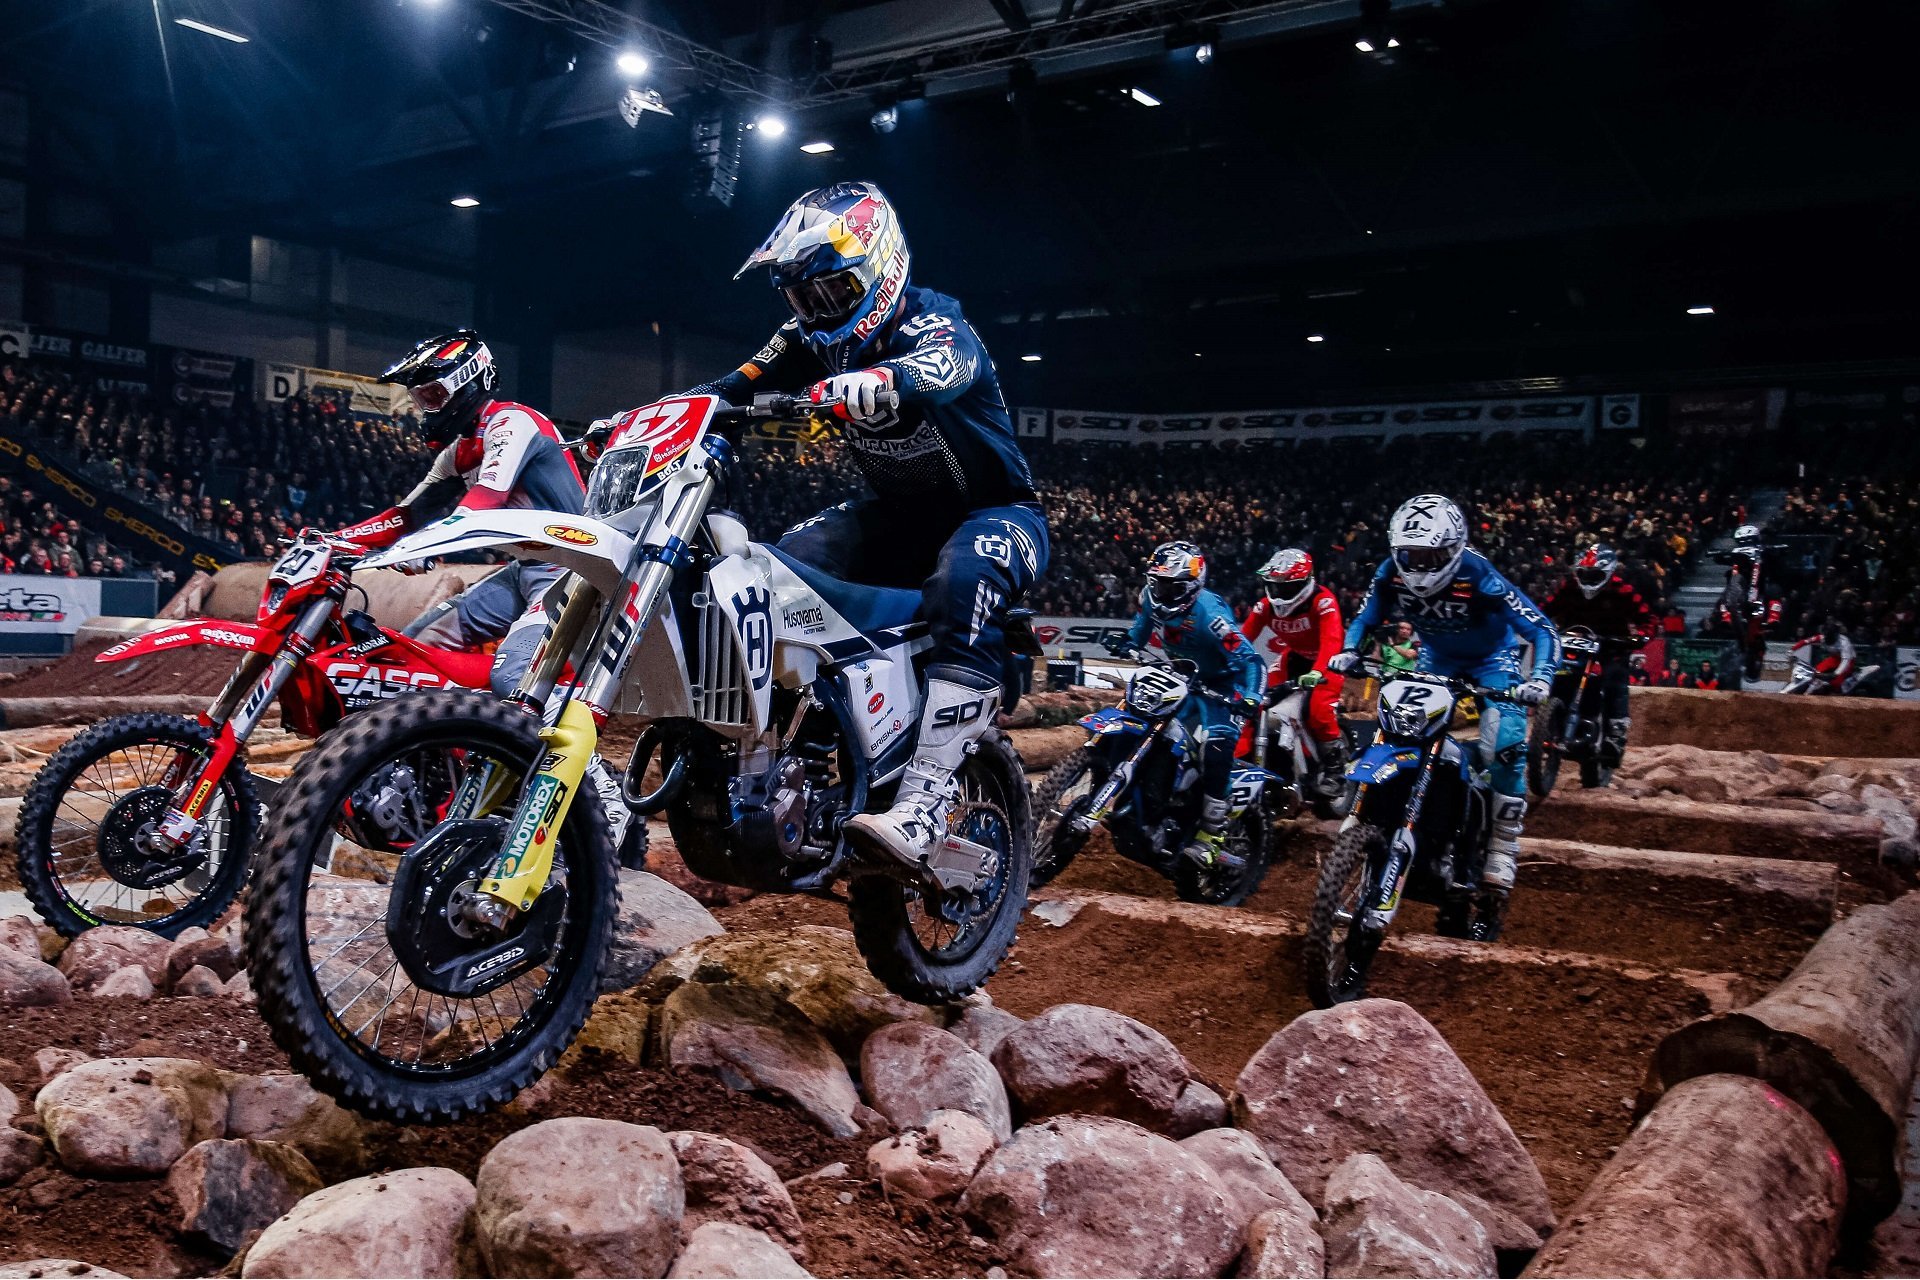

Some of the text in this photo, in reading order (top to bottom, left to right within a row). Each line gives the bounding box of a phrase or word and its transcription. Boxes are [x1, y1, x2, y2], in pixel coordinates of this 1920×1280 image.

[854, 293, 890, 340] Red
[881, 249, 905, 297] Bull
[30, 335, 72, 353] LFER
[274, 376, 289, 398] D
[1027, 417, 1038, 433] F
[1610, 405, 1631, 425] G
[656, 460, 681, 481] BOLT
[103, 505, 185, 556] SHERCO
[341, 515, 404, 540] GASGAS
[546, 525, 596, 543] FMF
[275, 548, 315, 577] 20
[0, 588, 61, 612] ta
[782, 606, 823, 629] Husqvarna
[154, 633, 191, 646] MOTUL
[1397, 686, 1433, 706] 12
[870, 728, 894, 751] BRISK
[508, 779, 555, 857] MOTOREX
[467, 946, 525, 978] ACERBIS
